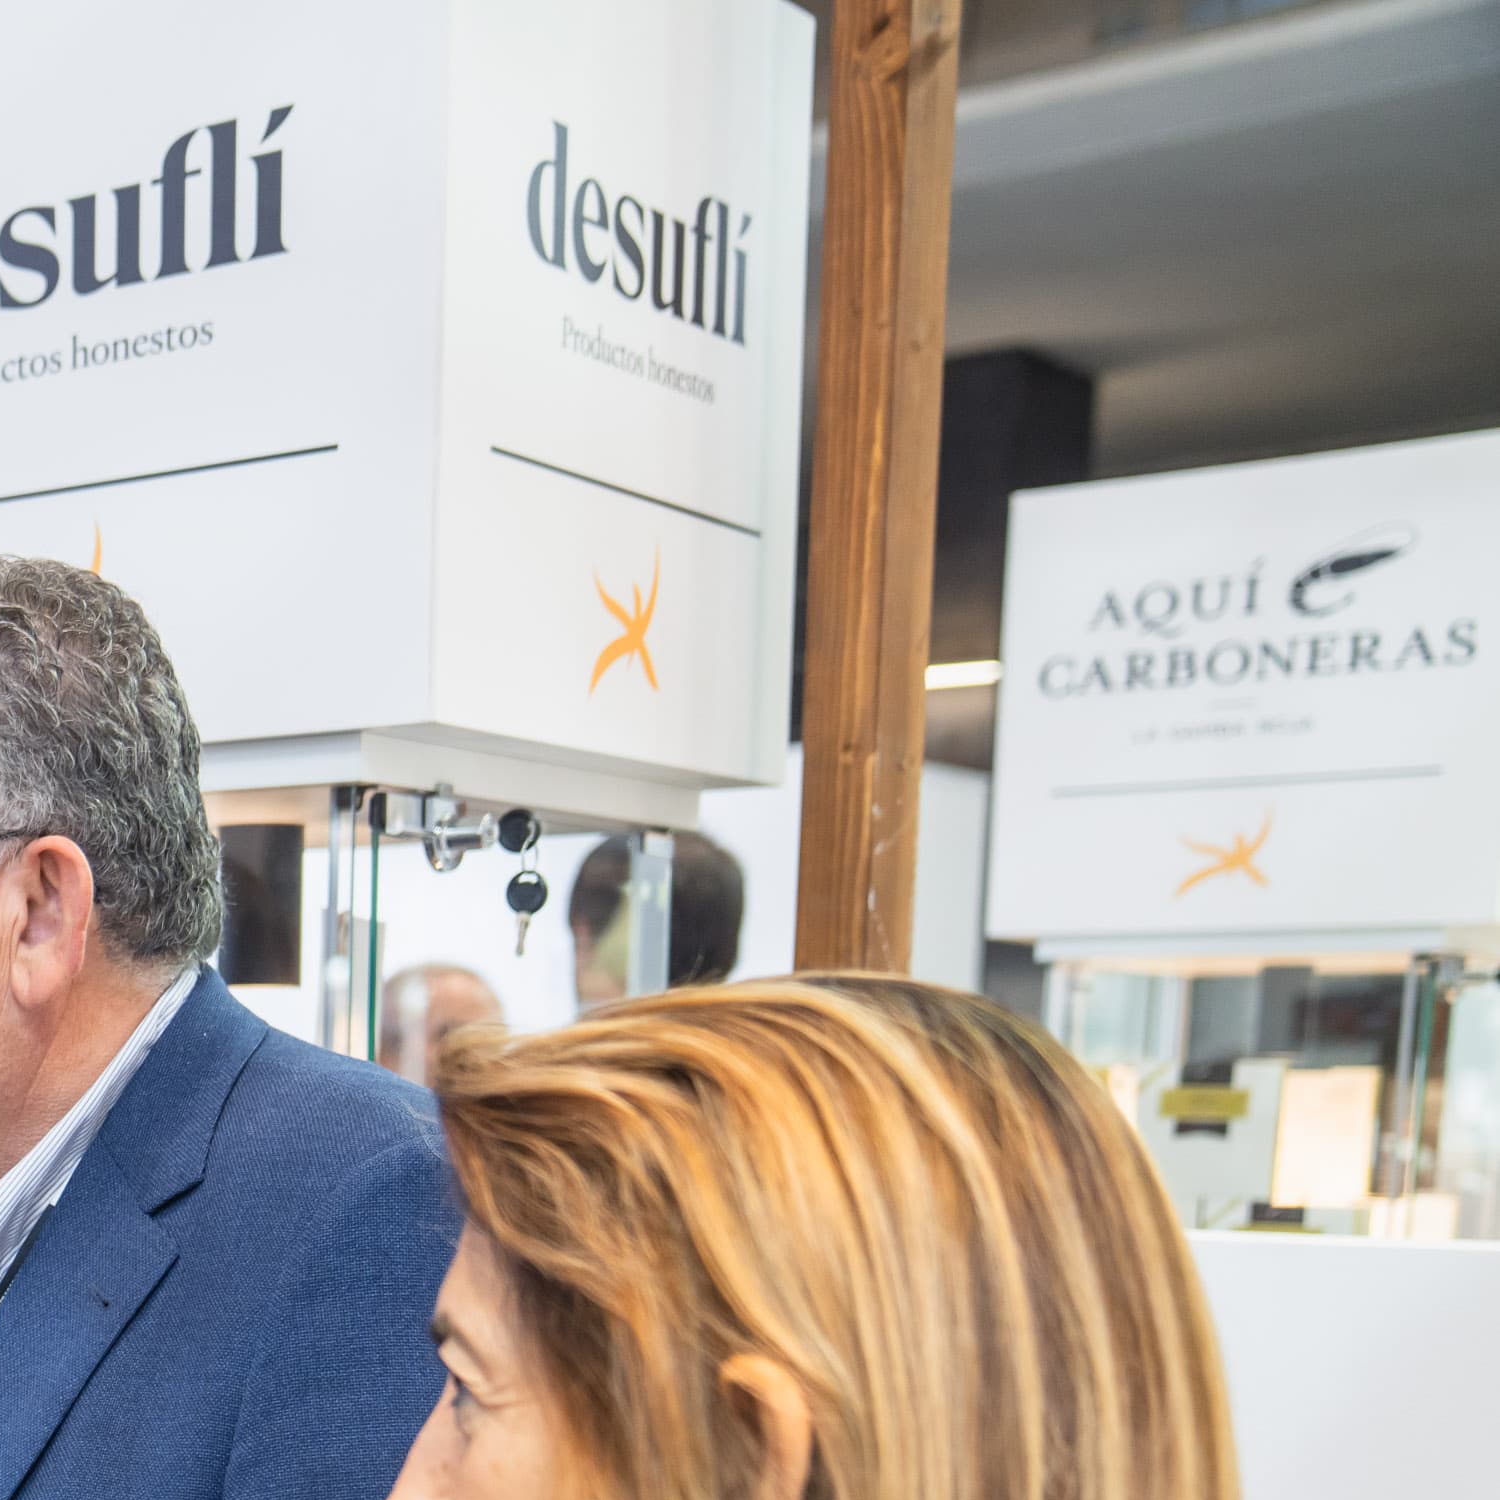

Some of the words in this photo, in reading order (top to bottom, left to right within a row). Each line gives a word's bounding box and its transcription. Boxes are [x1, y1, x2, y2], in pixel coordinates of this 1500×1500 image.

[526, 119, 752, 348] desuflí
[70, 318, 215, 371] honestos
[561, 314, 644, 378] Productos
[647, 345, 716, 406] honestos
[1089, 557, 1266, 638] AQUÍ
[1037, 618, 1480, 700] CARBONERAS
